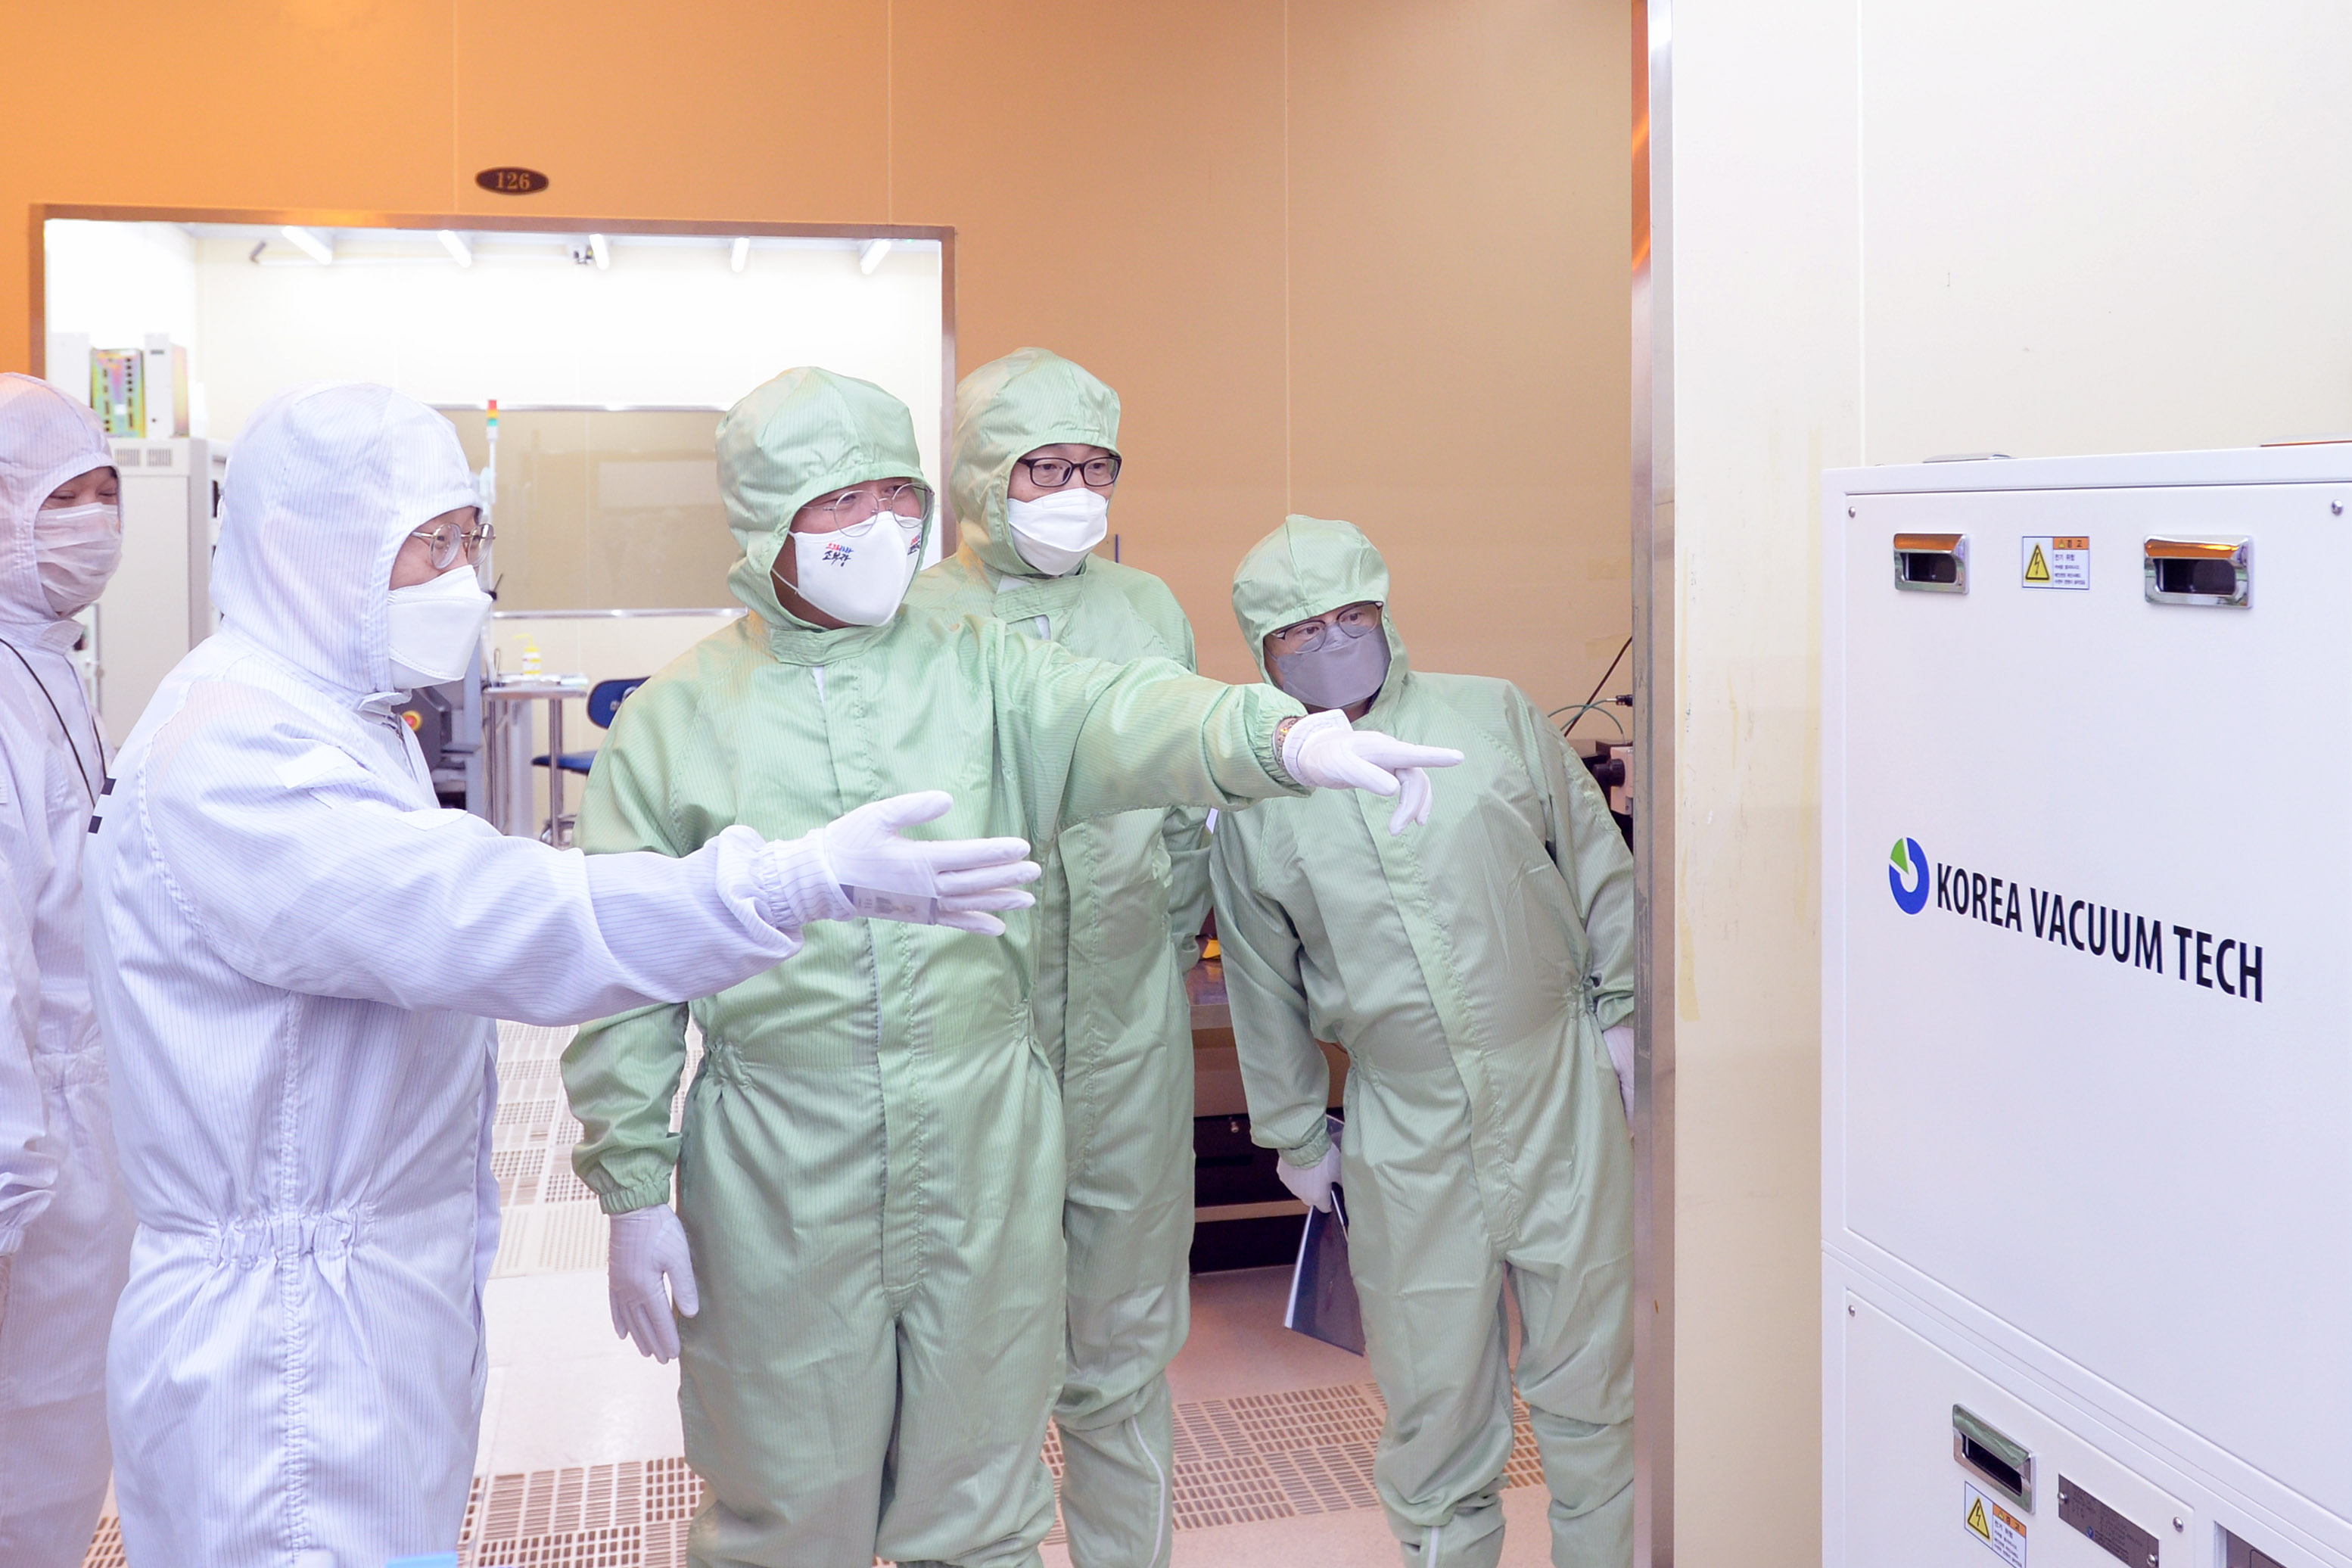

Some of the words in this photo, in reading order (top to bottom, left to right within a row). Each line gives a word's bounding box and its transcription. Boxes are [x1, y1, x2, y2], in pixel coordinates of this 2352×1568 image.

[496, 172, 530, 189] 126
[1937, 863, 2023, 932] KOREA
[2030, 887, 2163, 974] VACUUM
[2173, 925, 2263, 1003] TECH
